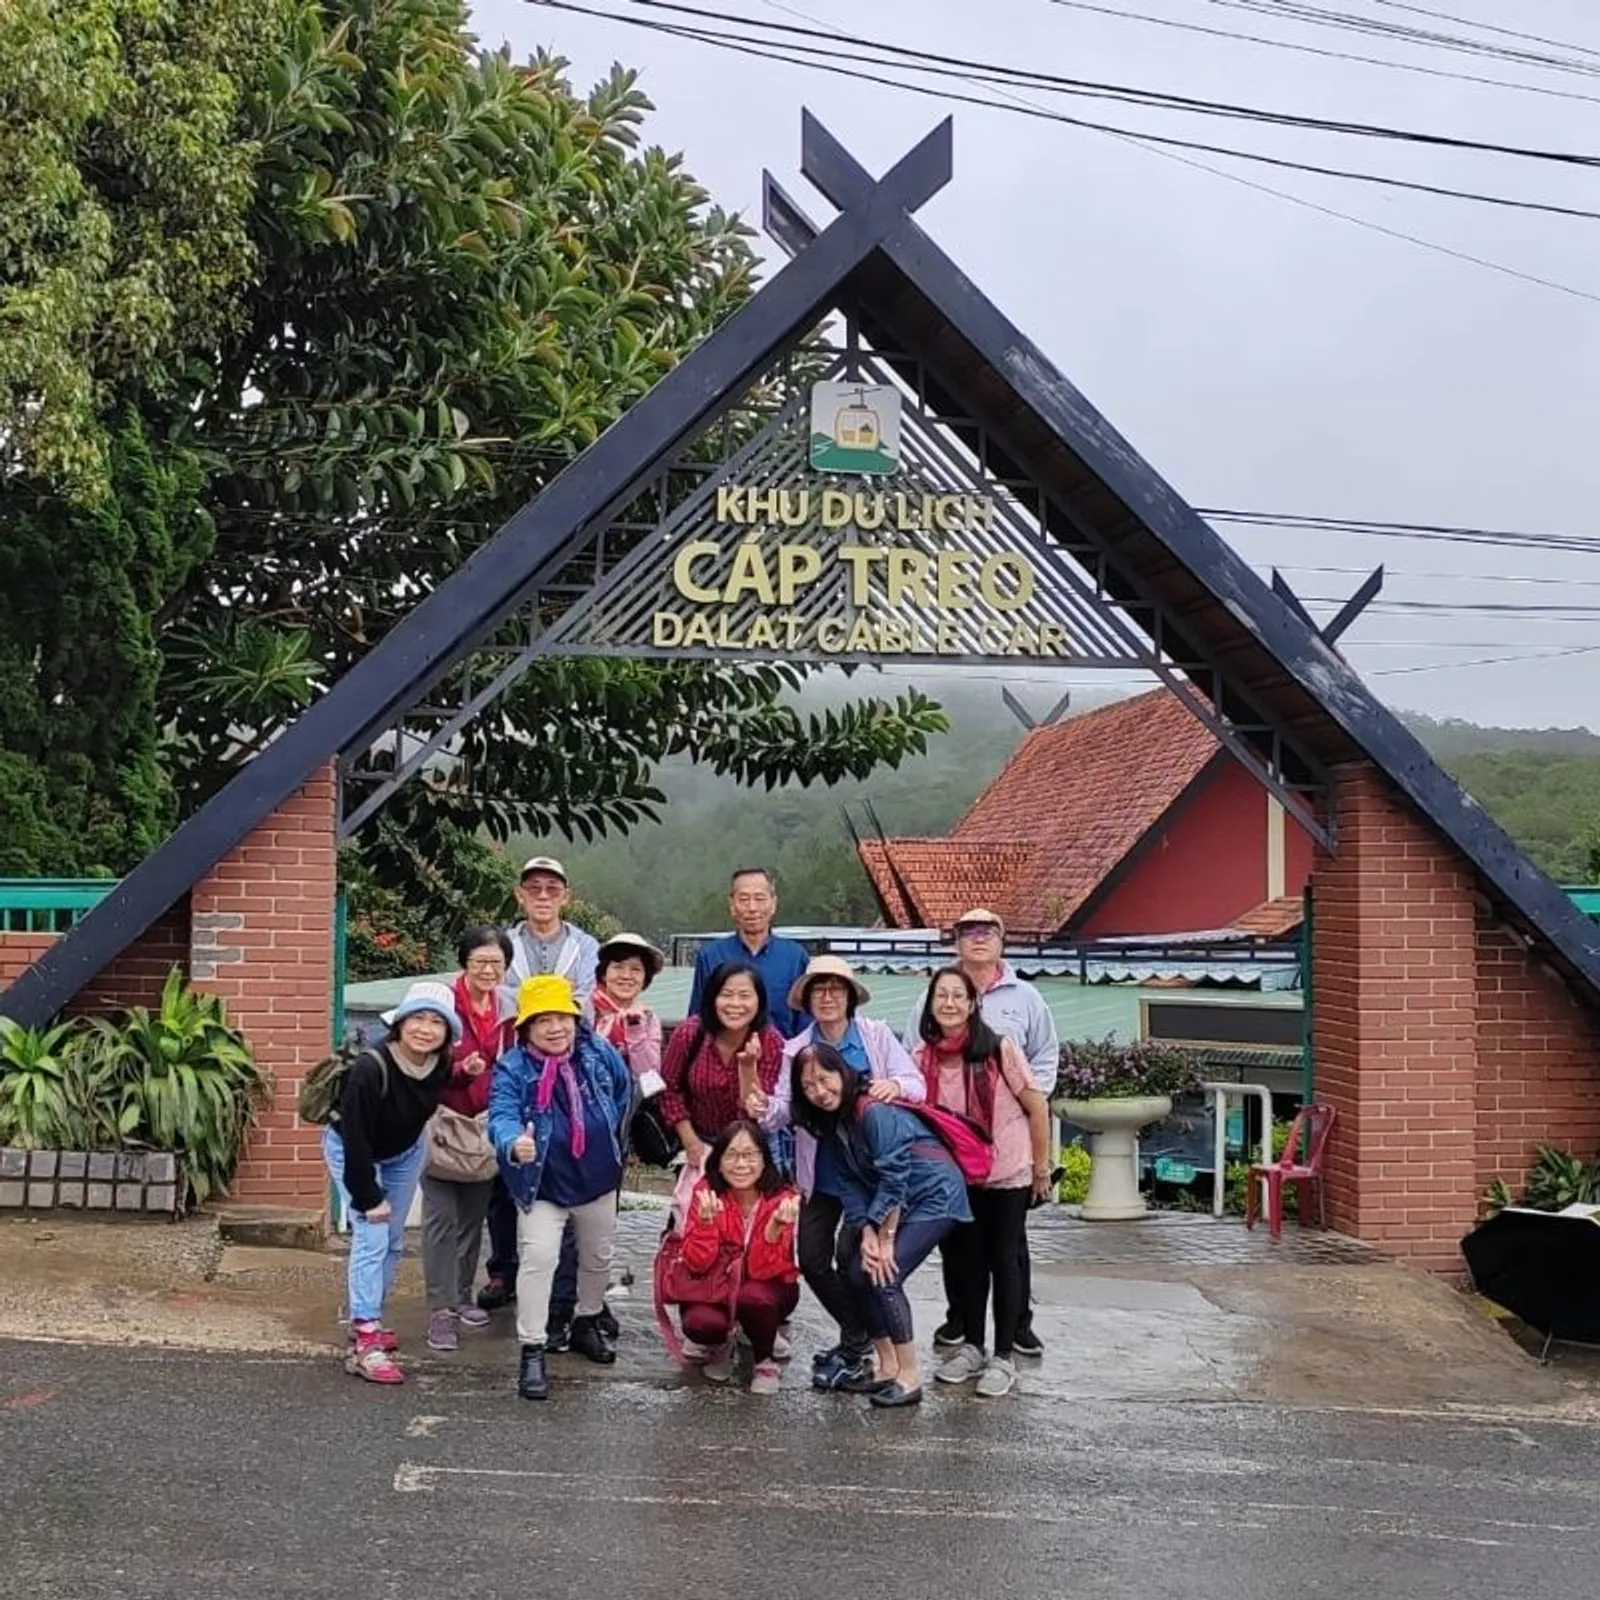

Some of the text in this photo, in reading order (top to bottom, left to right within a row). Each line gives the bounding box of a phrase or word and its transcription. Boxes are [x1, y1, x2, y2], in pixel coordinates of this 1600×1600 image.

[717, 486, 808, 526] KHU
[822, 490, 885, 530] DU
[674, 532, 1034, 611] CÁP TREO
[653, 611, 1072, 657] DALAT CABLE CAR
